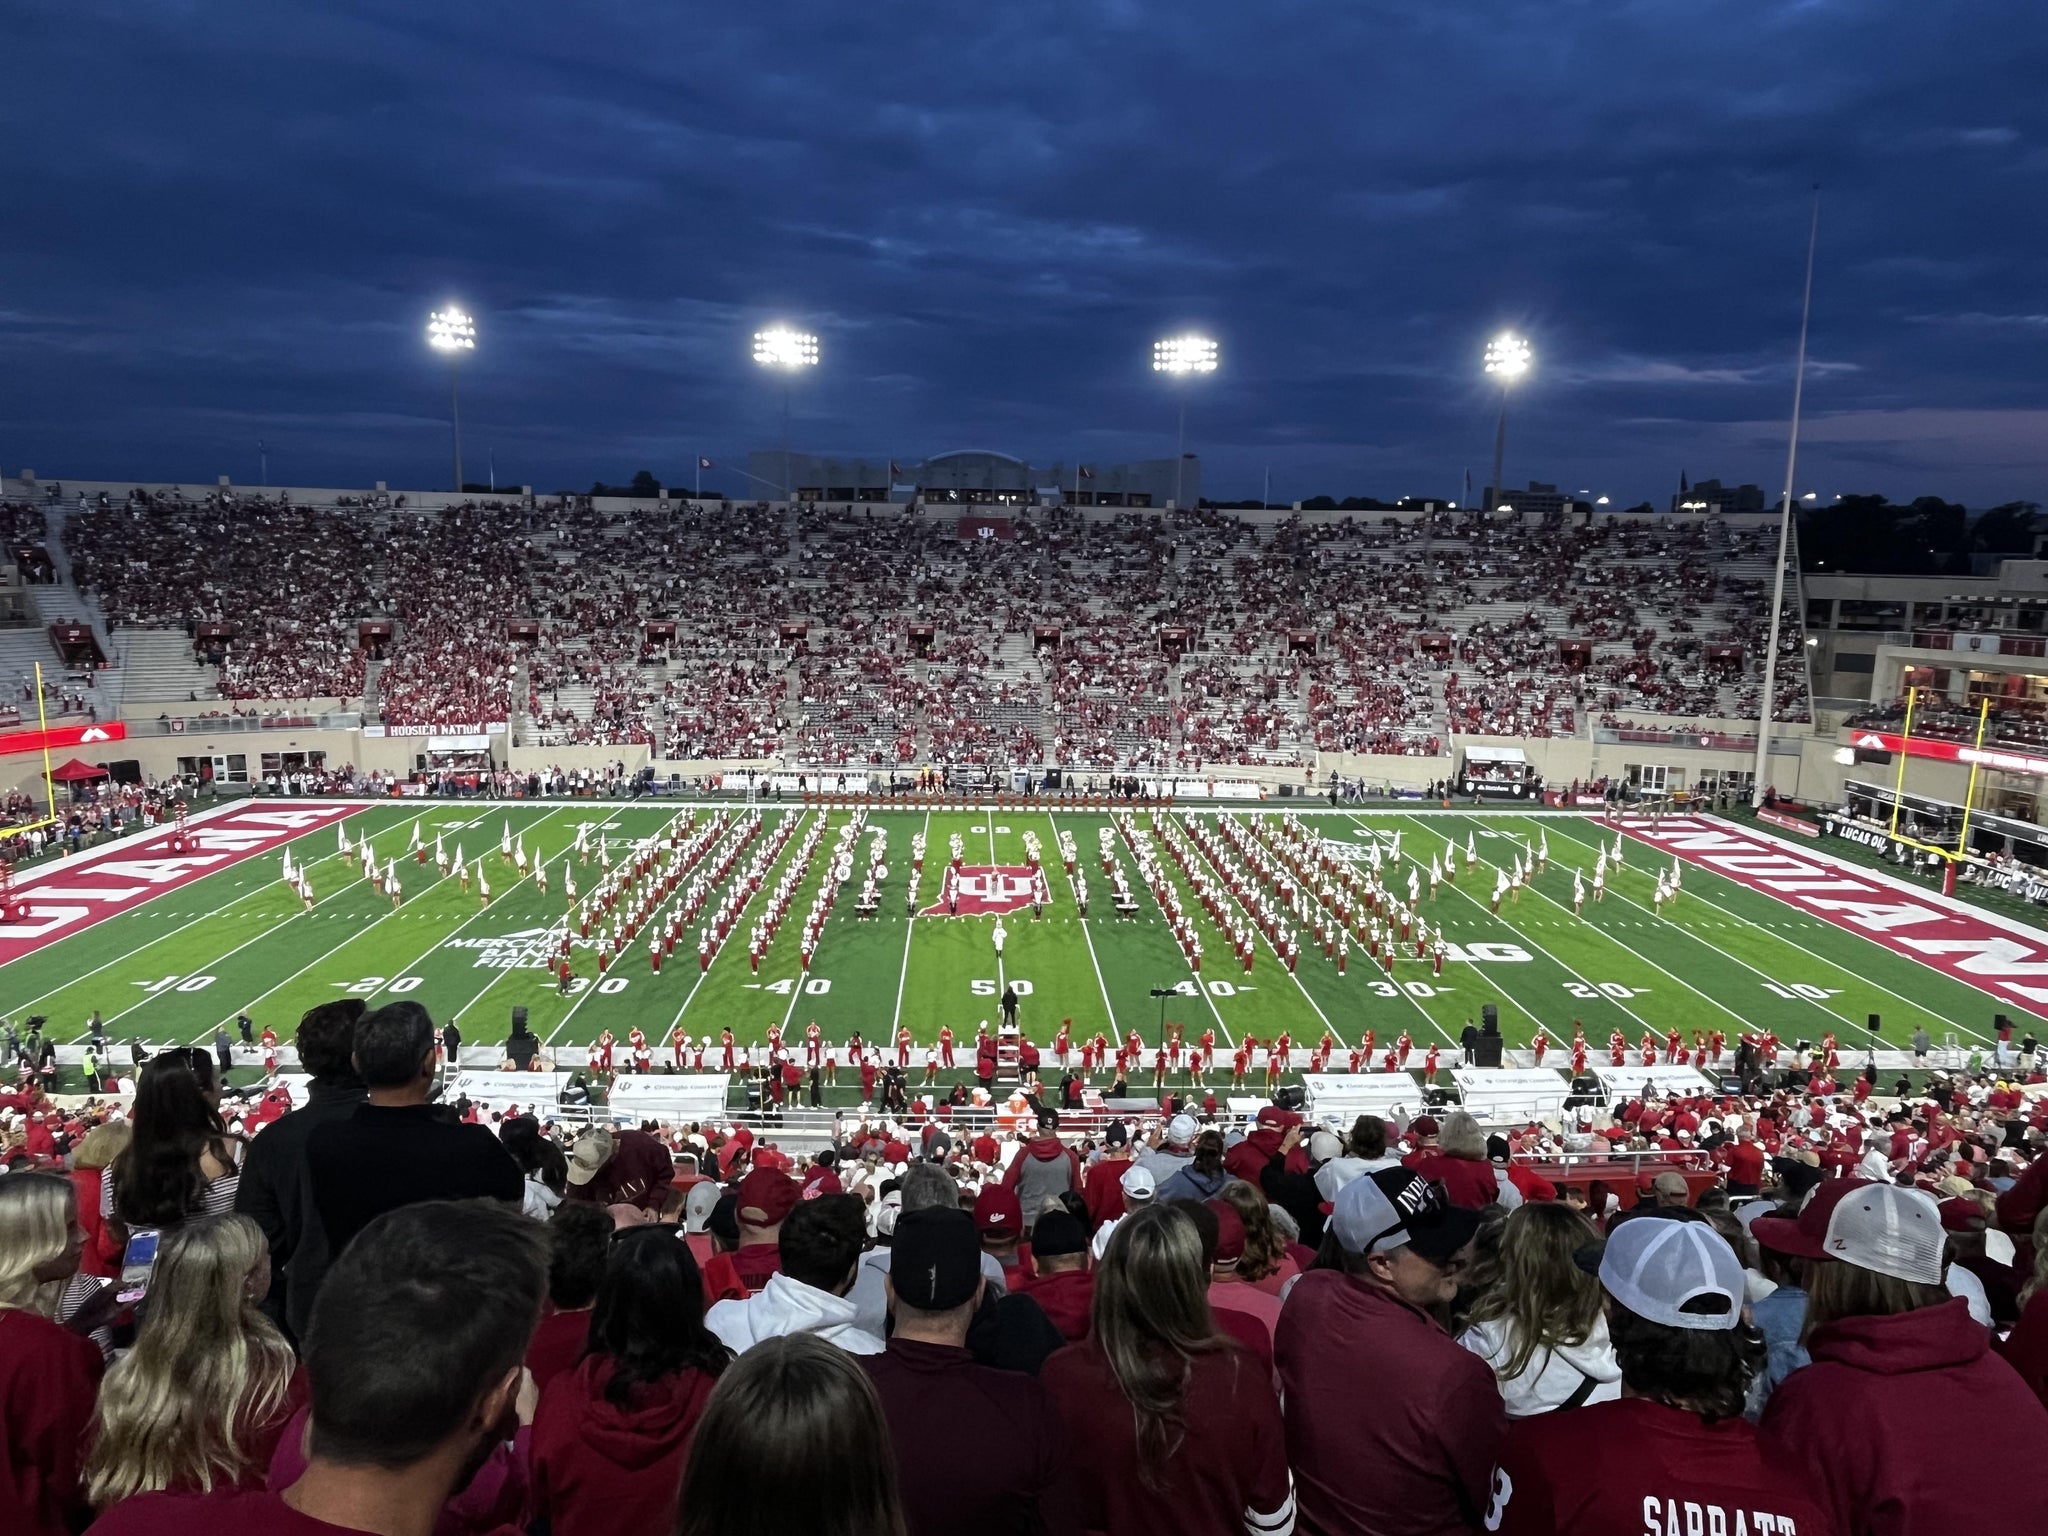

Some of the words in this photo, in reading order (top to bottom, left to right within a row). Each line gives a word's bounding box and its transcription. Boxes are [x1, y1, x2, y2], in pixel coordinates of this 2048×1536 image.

[390, 725, 437, 736] HOOSIER
[441, 725, 480, 735] NATION
[1839, 826, 1870, 846] LUCAS
[1870, 833, 1888, 850] OIL
[1619, 820, 2048, 1003] INDIAN
[472, 958, 550, 968] FIELD
[144, 976, 217, 992] 10
[346, 977, 424, 992] 20
[764, 979, 832, 995] 40
[971, 979, 1034, 995] 50
[1172, 980, 1237, 996] 40
[1366, 981, 1437, 997] 30
[1561, 982, 1635, 998] 20
[1760, 983, 1831, 999] 10
